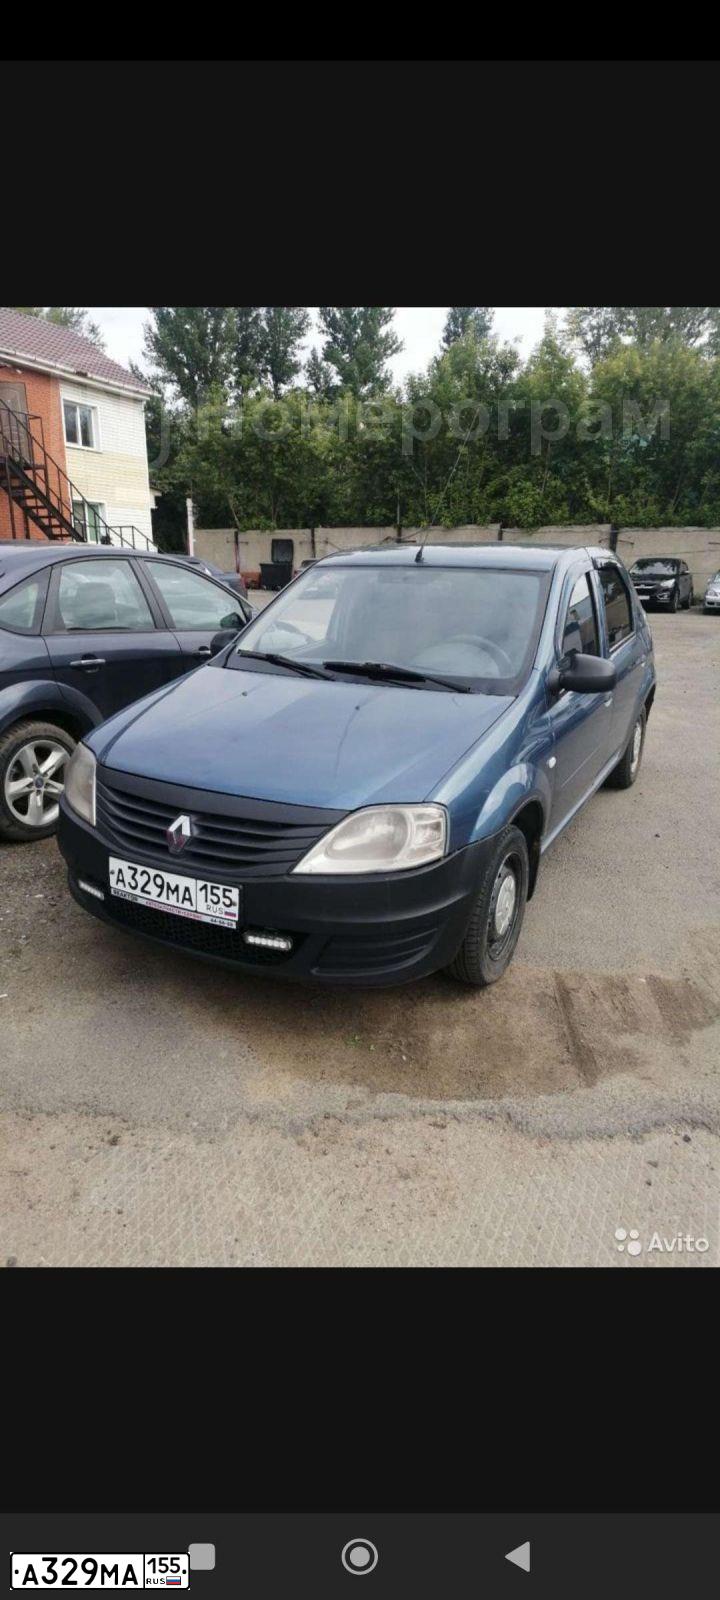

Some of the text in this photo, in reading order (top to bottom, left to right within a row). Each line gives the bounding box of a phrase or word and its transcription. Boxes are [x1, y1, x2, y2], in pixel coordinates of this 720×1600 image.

[116, 865, 233, 908] А329МА 155
[206, 904, 224, 915] RUS
